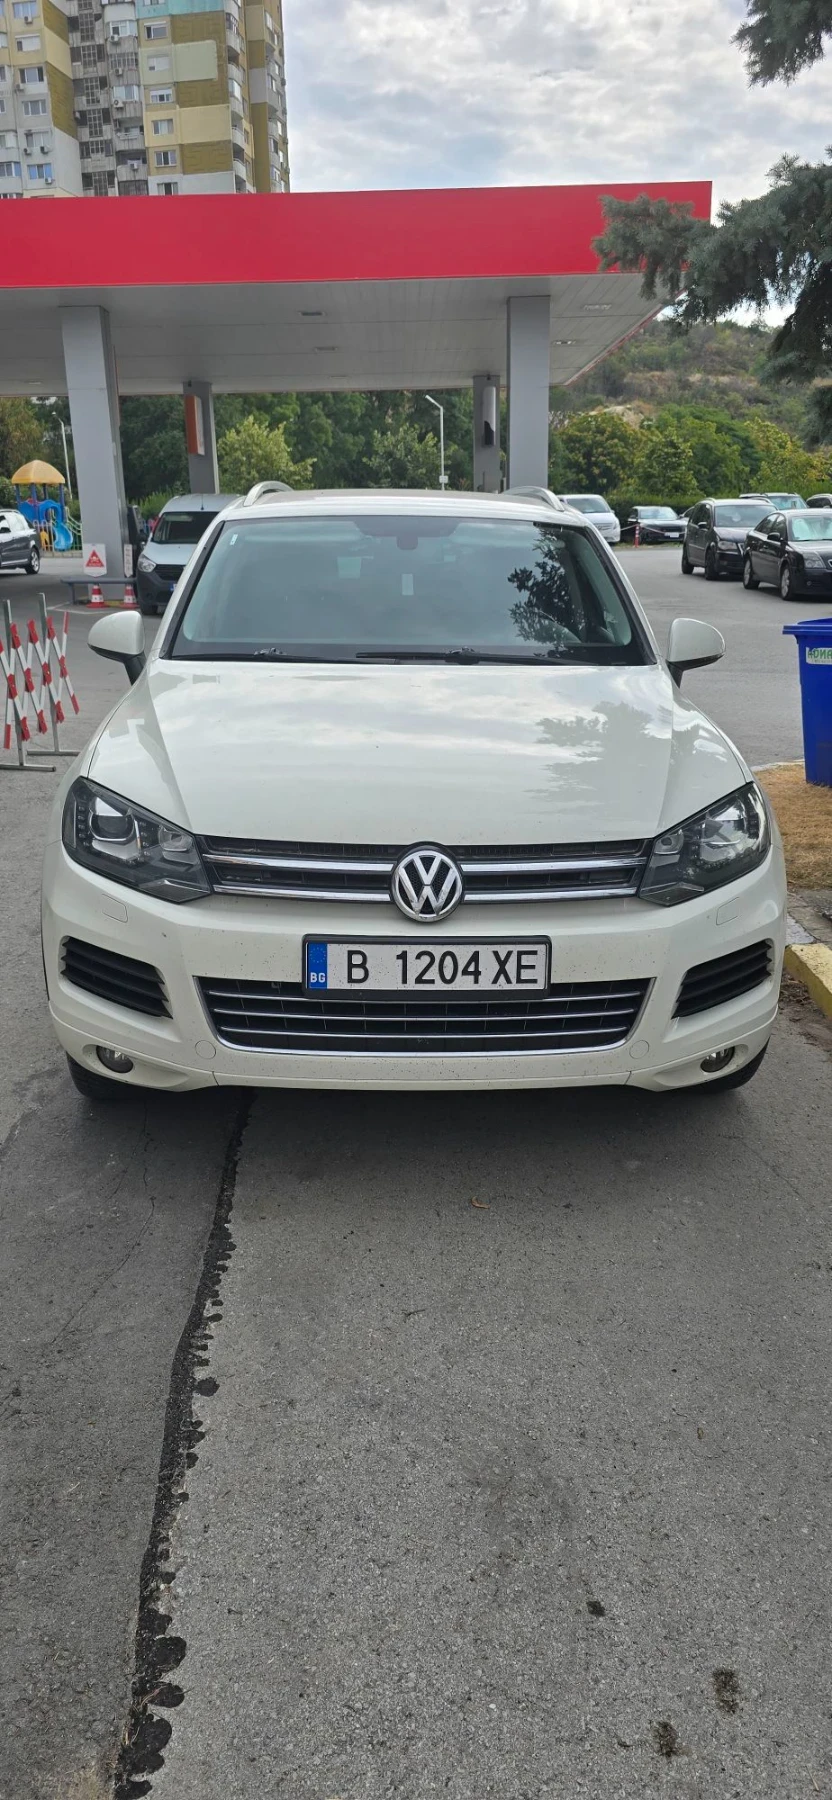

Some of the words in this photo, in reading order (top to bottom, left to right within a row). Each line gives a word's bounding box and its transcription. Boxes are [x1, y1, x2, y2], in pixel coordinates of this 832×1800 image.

[393, 846, 462, 921] VW
[310, 972, 326, 983] BG
[347, 950, 369, 984] B
[396, 950, 482, 985] 1204
[491, 950, 538, 984] XE
